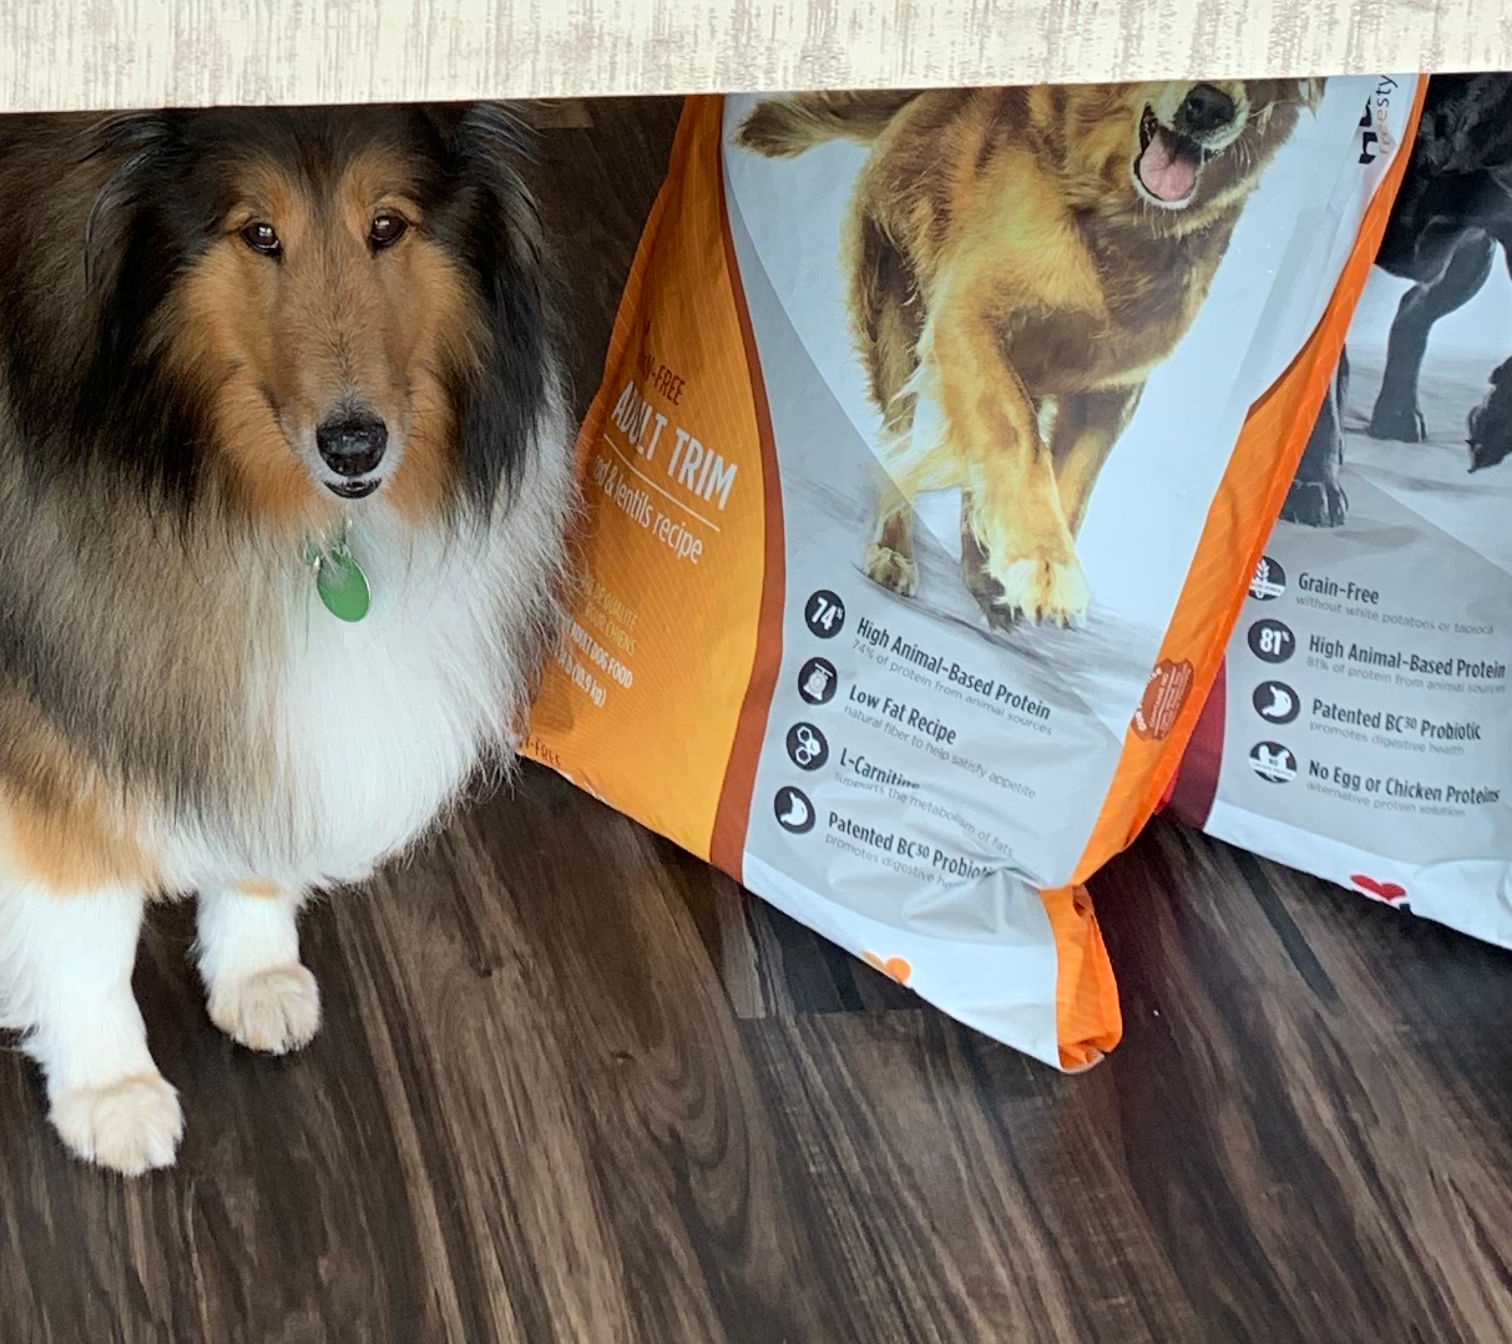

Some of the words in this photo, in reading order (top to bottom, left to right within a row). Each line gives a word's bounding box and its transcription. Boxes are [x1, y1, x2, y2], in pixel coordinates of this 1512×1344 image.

[611, 379, 668, 461] ADULT
[667, 426, 738, 512] TRIM
[615, 474, 654, 529] lentils
[652, 511, 704, 564] recipe
[1298, 572, 1380, 605] Grain-Free
[1296, 595, 1342, 614] without
[1345, 604, 1380, 622] white
[1381, 612, 1435, 631] potatoes
[1438, 620, 1452, 632] or
[607, 657, 633, 689] FOOD
[856, 616, 890, 649] High
[890, 635, 995, 697] Animal-Based
[994, 684, 1052, 721] Protein
[1309, 634, 1344, 660] High
[1348, 643, 1453, 676] Animal-Based
[1456, 660, 1507, 680] Protein
[1330, 661, 1345, 675] of
[1347, 665, 1392, 683] protein
[1394, 672, 1424, 688] from
[1426, 678, 1466, 693] animal
[852, 639, 875, 659] 74%
[876, 651, 889, 666] of
[889, 659, 932, 687] protein
[934, 679, 963, 700] from
[965, 694, 1006, 719] animal
[1007, 711, 1053, 737] sources
[849, 684, 881, 709] Low
[882, 696, 907, 723] Fat
[907, 708, 957, 746] Recipe
[1309, 720, 1368, 744] promotes
[1371, 732, 1427, 754] digestive
[1428, 742, 1465, 756] health
[1312, 698, 1382, 729] Patented
[1420, 719, 1483, 741] Probiotic
[844, 704, 883, 730] natural
[884, 721, 910, 745] fiber
[911, 732, 925, 750] to
[925, 740, 951, 762] help
[951, 750, 988, 779] satisfy
[988, 769, 1037, 801] appetite
[1306, 781, 1371, 807] alternative
[1373, 792, 1417, 813] protein
[1419, 801, 1466, 817] solution
[1308, 759, 1330, 780] No
[1333, 765, 1361, 792] Egg
[1365, 777, 1382, 793] or
[1384, 776, 1442, 802] Chicken
[1445, 784, 1501, 805] Proteins
[828, 811, 895, 851] Patented
[833, 771, 886, 797] supports
[888, 787, 908, 804] the
[908, 796, 977, 835] metabolism
[977, 827, 991, 842] of
[991, 836, 1014, 858] fats
[824, 833, 879, 862] promotes
[881, 854, 936, 884] digestive
